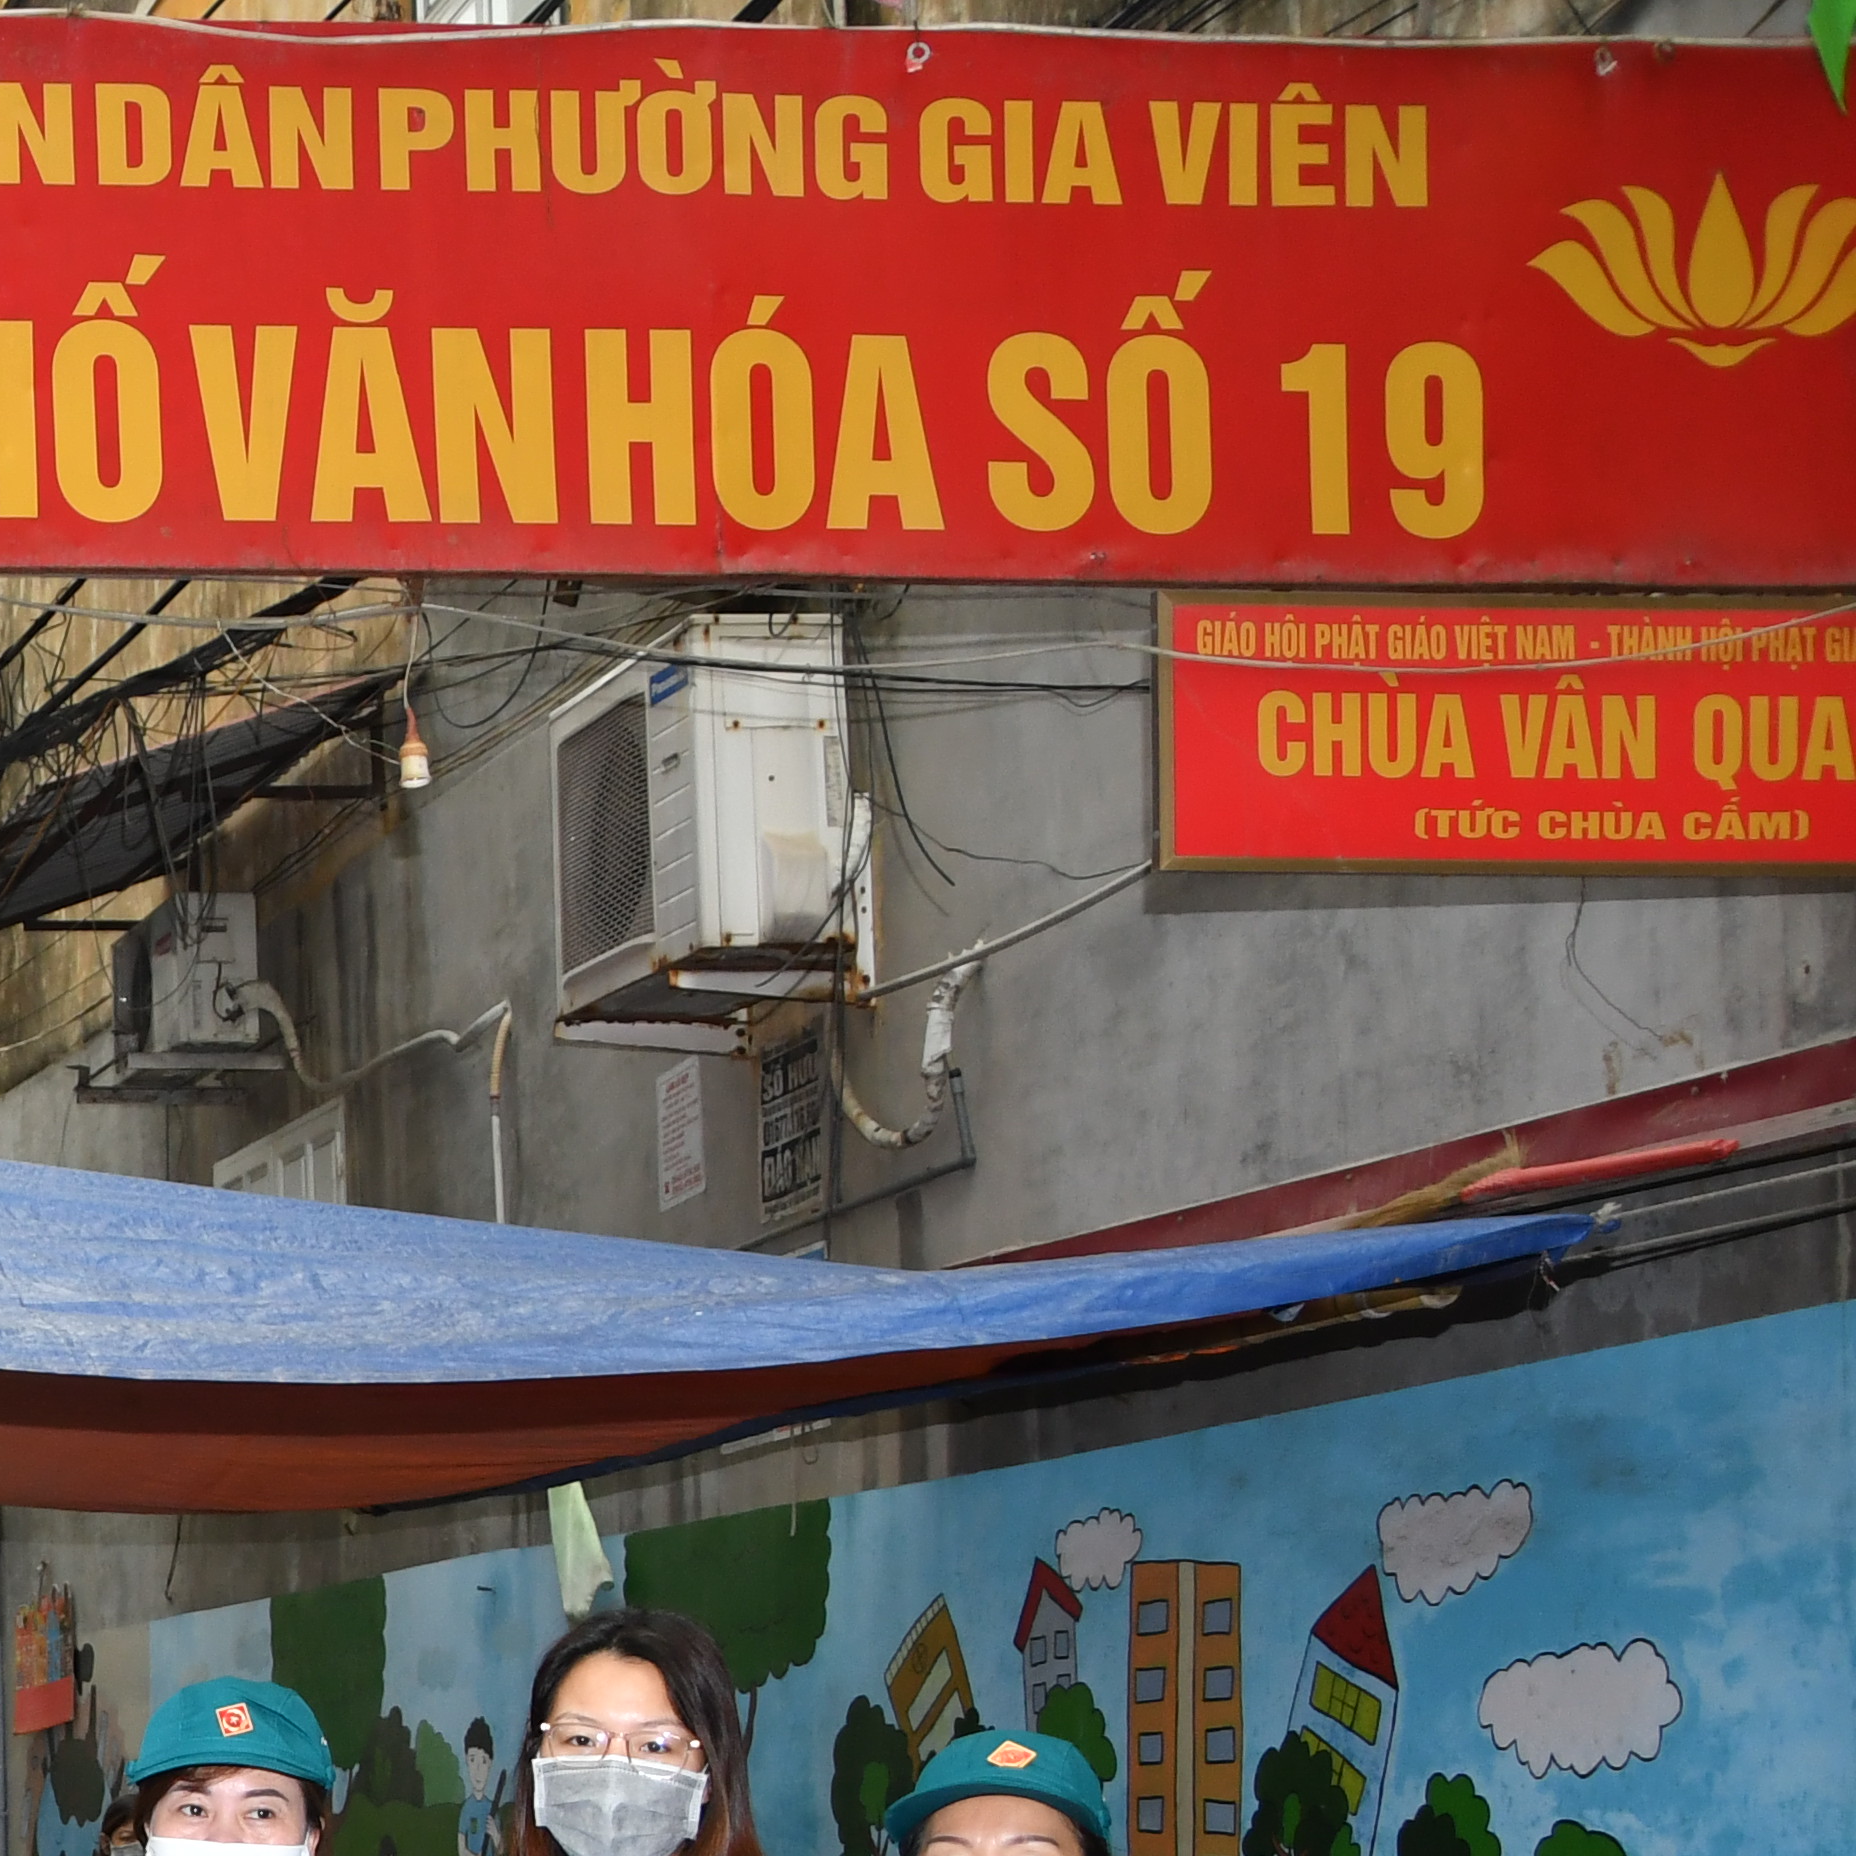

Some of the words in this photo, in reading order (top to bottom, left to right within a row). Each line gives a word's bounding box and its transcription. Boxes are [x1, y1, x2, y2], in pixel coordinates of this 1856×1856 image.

[97, 66, 352, 188] DÂN
[381, 57, 887, 198] PHƯỜNG
[922, 98, 1121, 203] GIA
[1152, 84, 1427, 207] VIÊN
[192, 289, 557, 522] VĂN
[587, 297, 943, 529] HÓA
[990, 272, 1211, 534] SỐ
[1284, 343, 1483, 538] 19
[1197, 611, 1255, 657] GIÁO
[1264, 616, 1307, 664] HỘI
[1315, 615, 1379, 667] PHẬT
[1387, 612, 1447, 661] GIÁO
[1454, 617, 1508, 668] VIỆT
[1517, 623, 1575, 661] NAM
[1607, 616, 1692, 662] THÀNH
[1700, 618, 1743, 671] HỘI
[1257, 671, 1475, 779] CHÙA
[1500, 674, 1656, 780] VÂN
[1414, 799, 1521, 840] (TỨC
[1537, 802, 1667, 841] CHÙA
